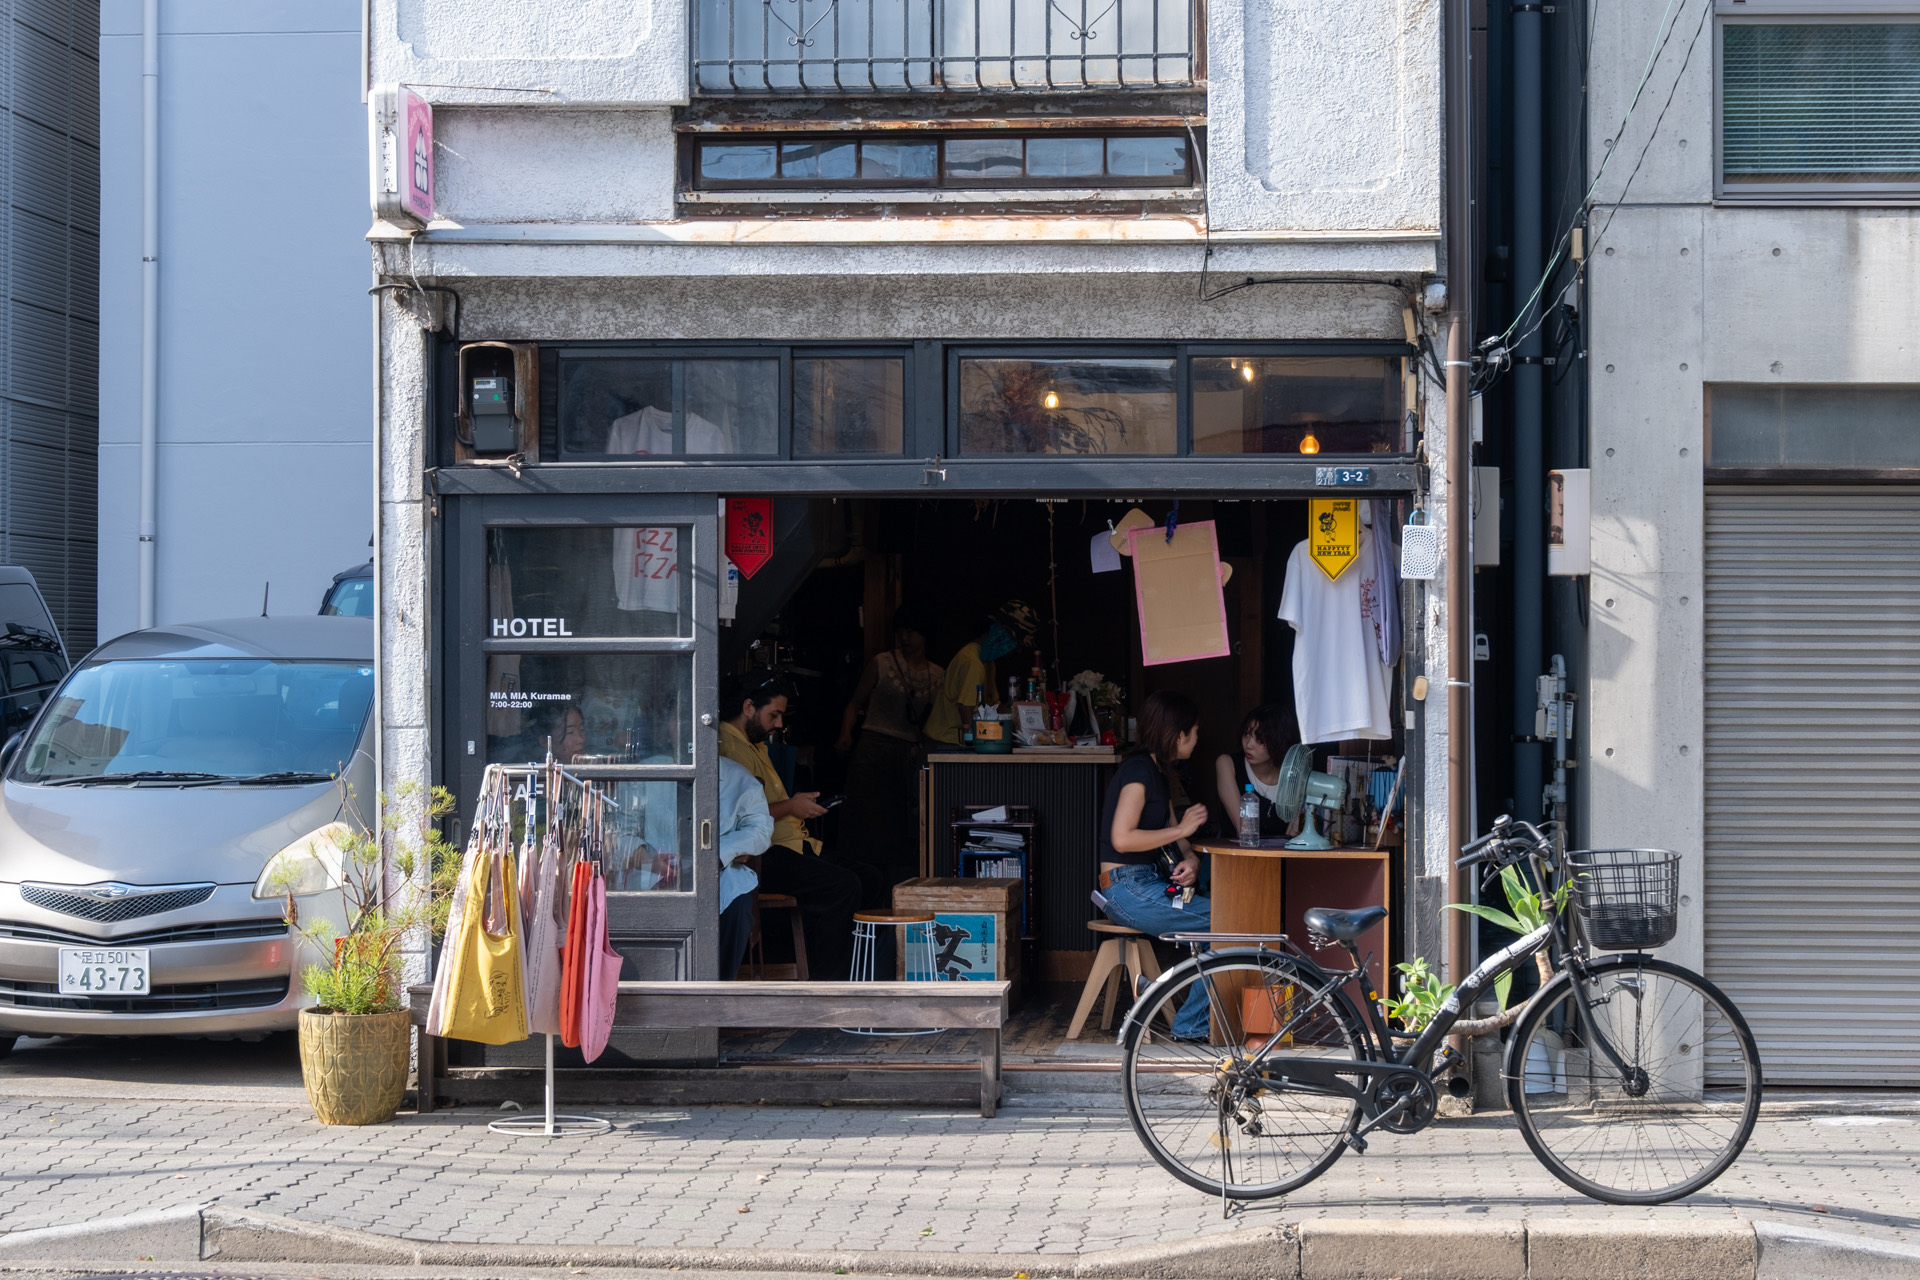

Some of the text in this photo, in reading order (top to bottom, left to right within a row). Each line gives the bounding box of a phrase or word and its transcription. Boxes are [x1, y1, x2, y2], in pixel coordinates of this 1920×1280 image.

[1342, 471, 1363, 482] 3-2
[493, 618, 572, 636] HOTEL
[490, 692, 572, 700] MIA MIA Kuramae
[66, 967, 145, 991] な 43-73
